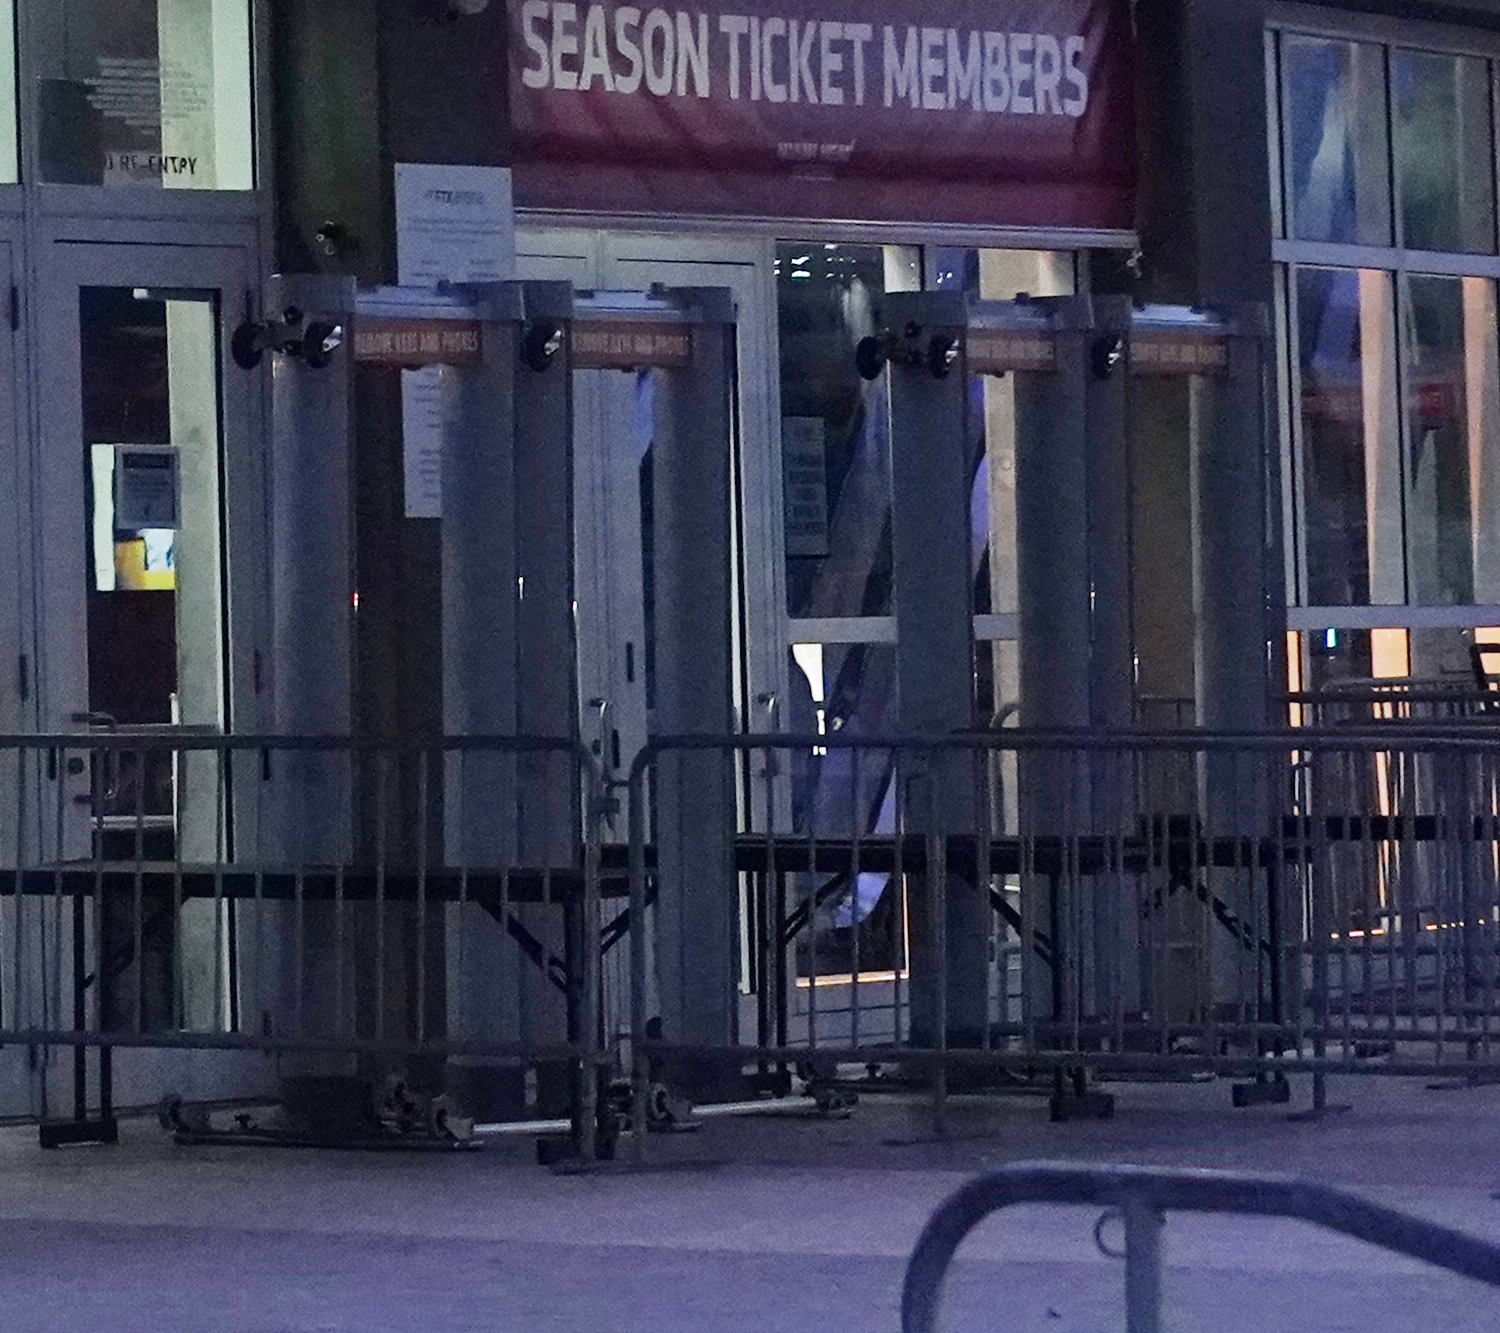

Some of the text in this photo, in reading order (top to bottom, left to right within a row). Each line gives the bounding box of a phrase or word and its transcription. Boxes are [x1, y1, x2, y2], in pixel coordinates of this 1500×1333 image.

[522, 0, 1090, 117] SEASON TICKET MEMBERS
